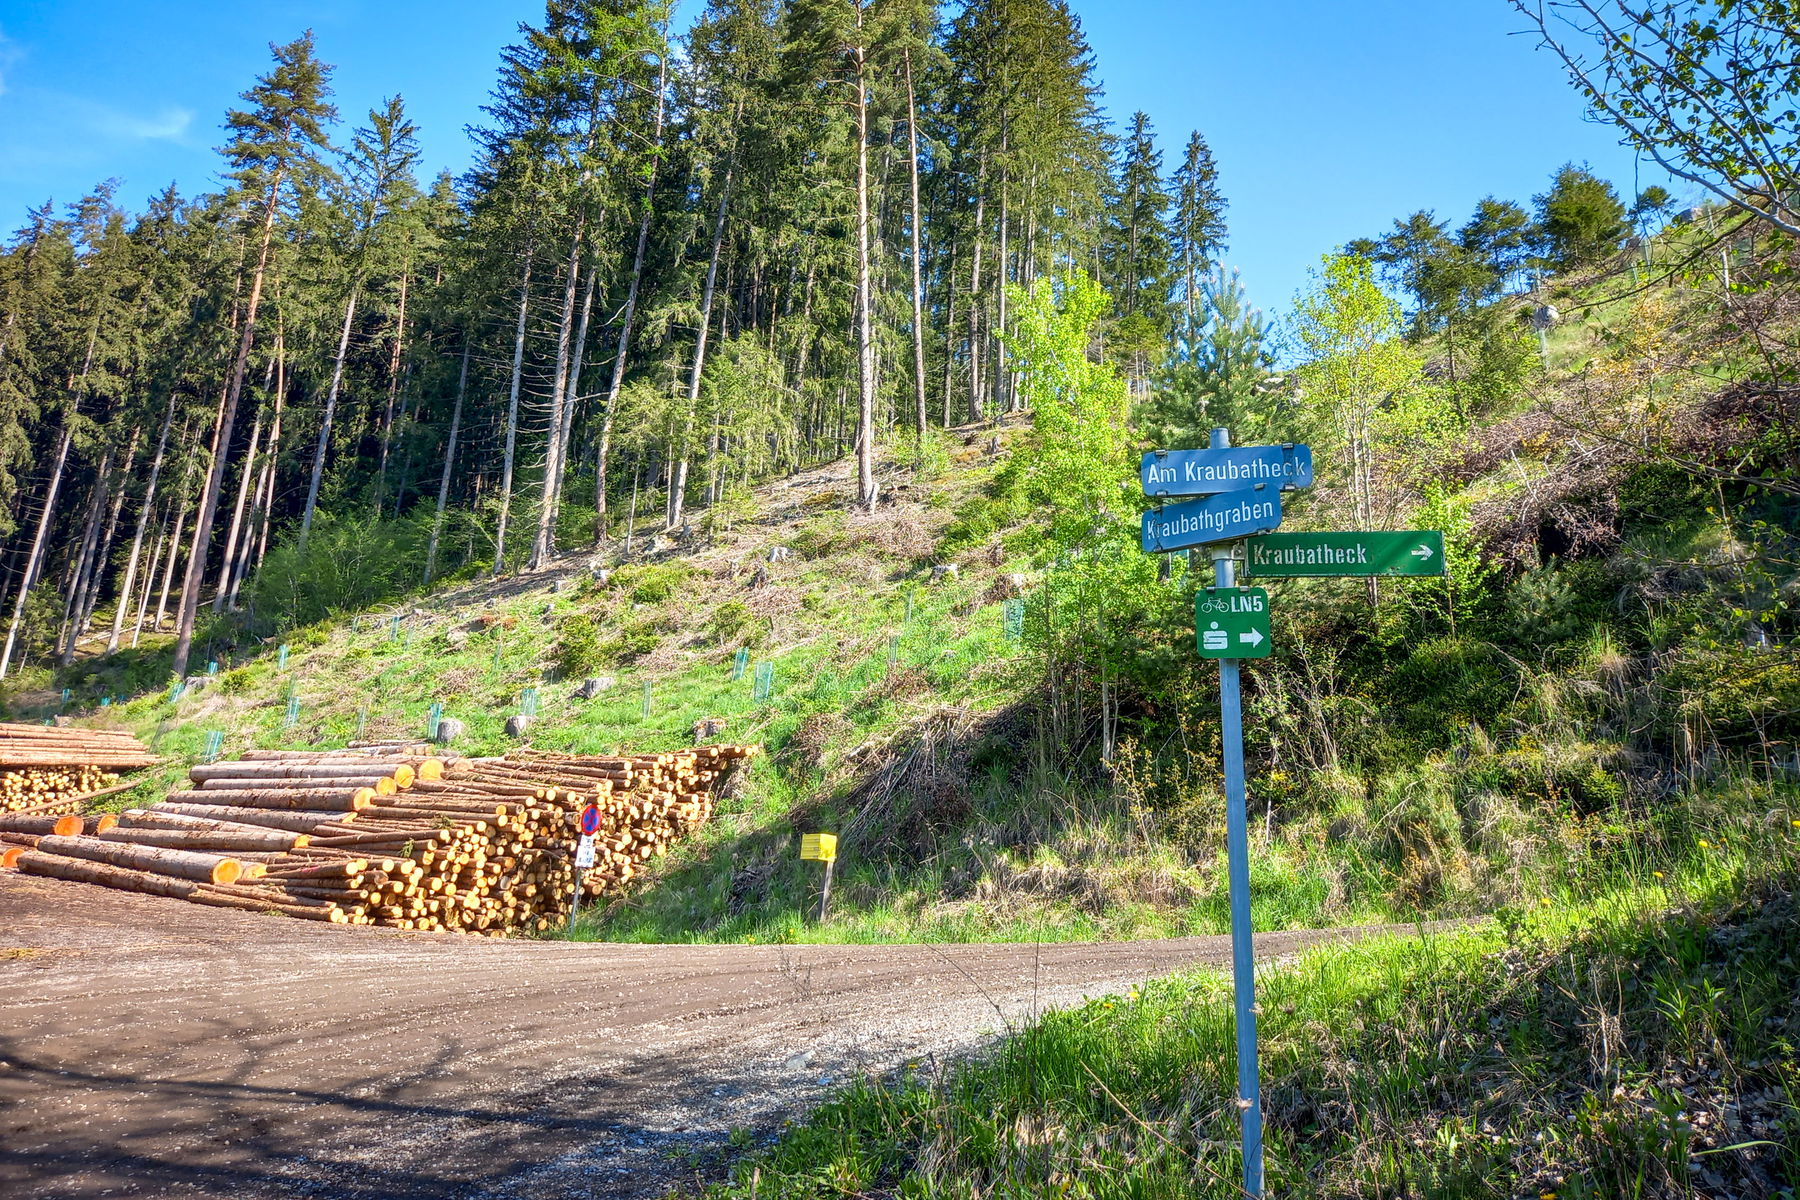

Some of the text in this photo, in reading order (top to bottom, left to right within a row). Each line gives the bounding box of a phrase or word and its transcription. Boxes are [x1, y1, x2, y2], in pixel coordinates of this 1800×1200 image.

[1147, 457, 1306, 484] Am Kraubatheck
[1147, 500, 1274, 540] Kraubathgraben
[1253, 543, 1368, 565] Kraubatheck
[1231, 595, 1264, 613] LN5
